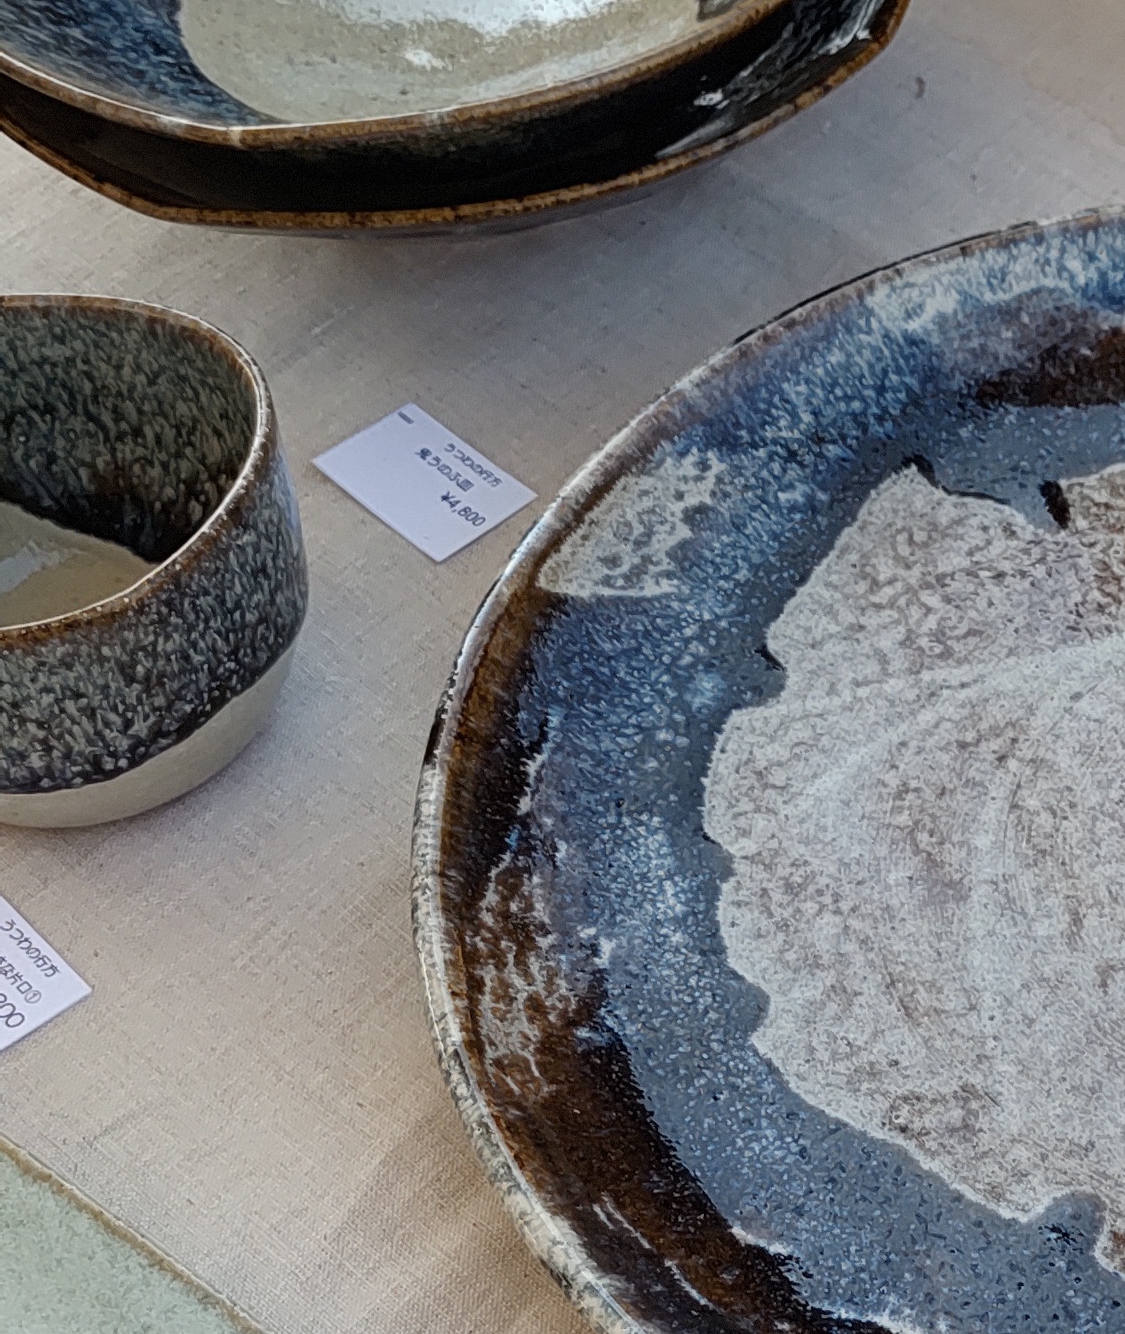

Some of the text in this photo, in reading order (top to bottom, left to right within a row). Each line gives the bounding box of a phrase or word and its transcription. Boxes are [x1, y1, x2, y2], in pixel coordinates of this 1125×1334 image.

[0, 919, 61, 978] うつわの行方
